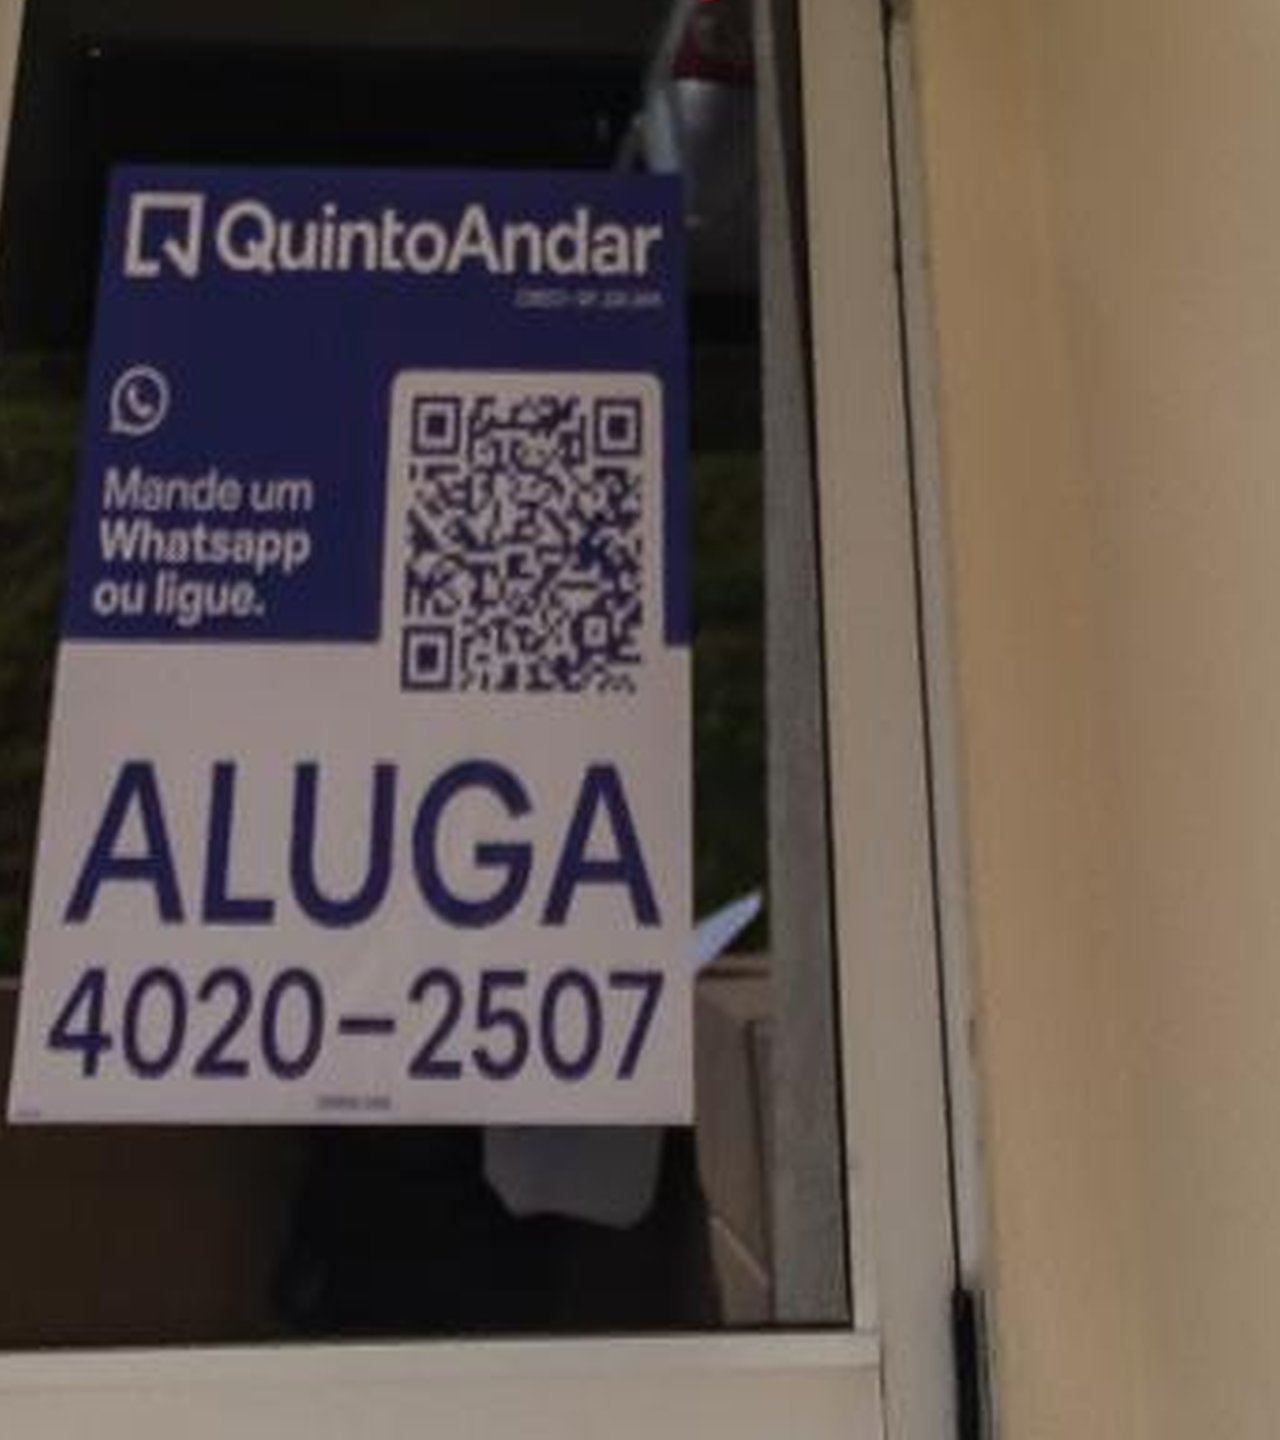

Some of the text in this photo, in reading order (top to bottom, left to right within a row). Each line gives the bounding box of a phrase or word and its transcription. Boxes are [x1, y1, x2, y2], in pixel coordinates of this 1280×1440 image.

[215, 199, 663, 275] QuintoAndar
[103, 469, 314, 512] Mande um
[100, 520, 311, 569] Whatsapp
[92, 571, 265, 626] ou ligue.
[64, 760, 661, 928] ALUGA
[47, 967, 664, 1080] 4020-2507
